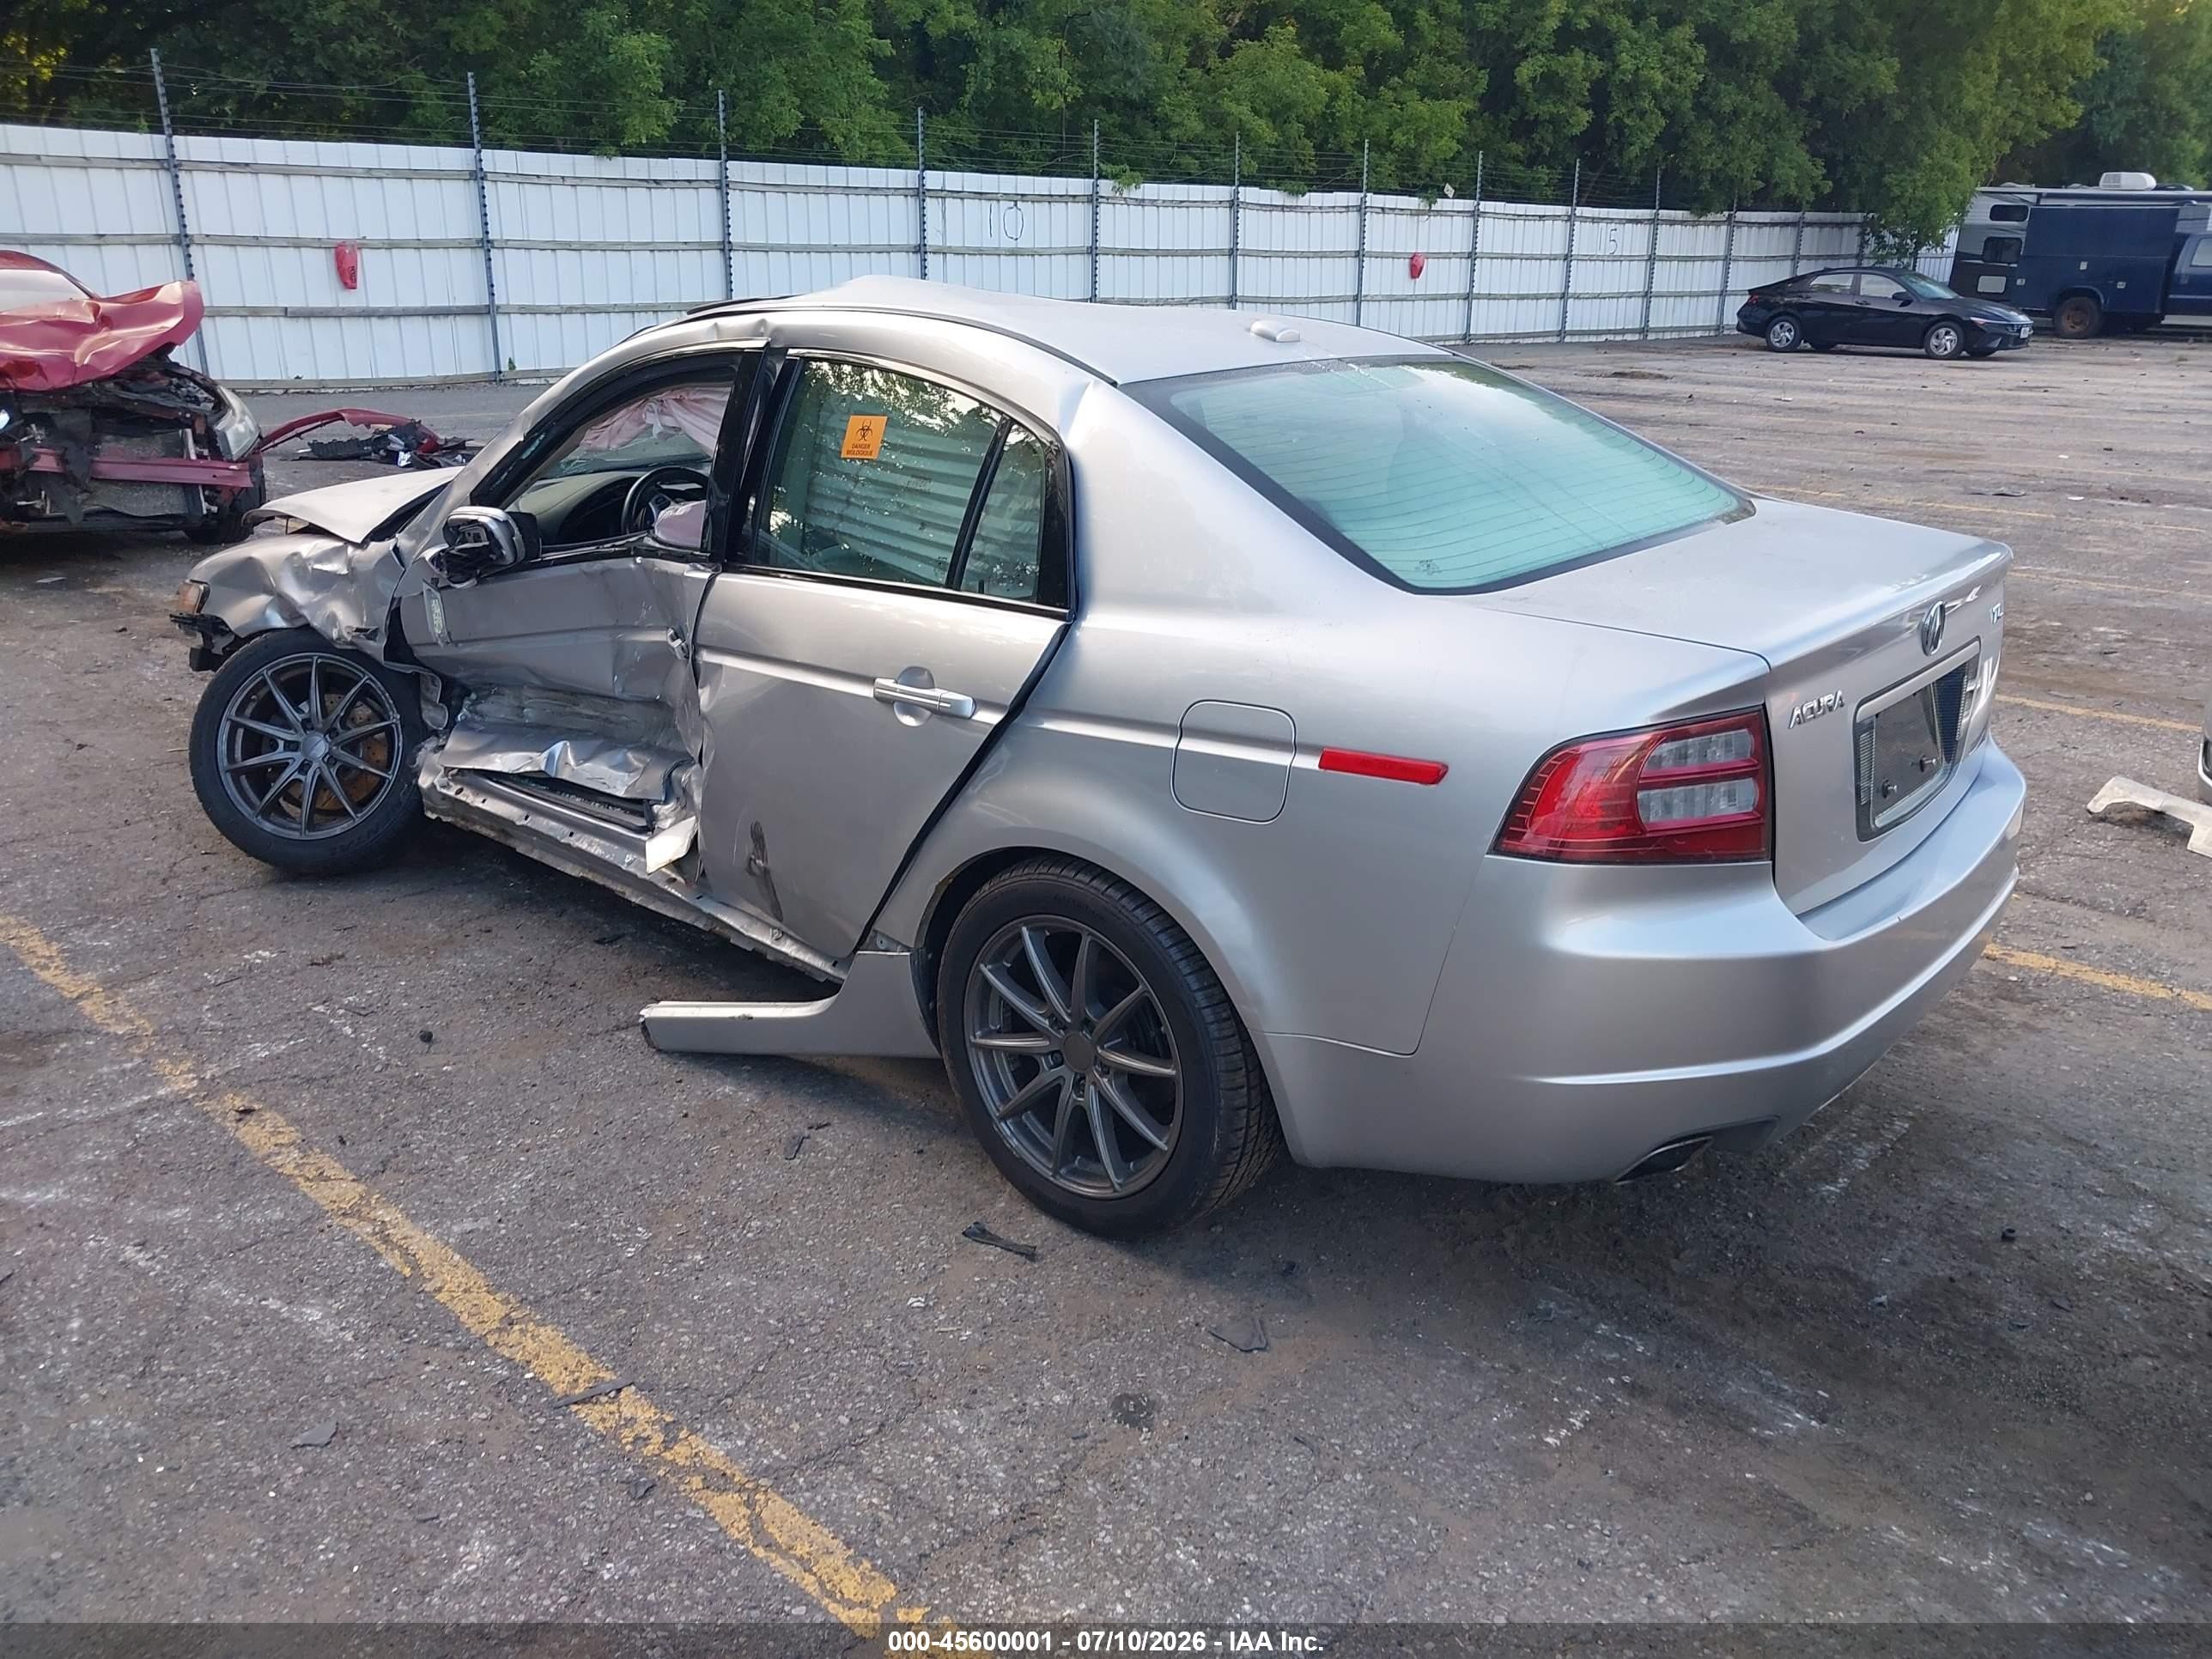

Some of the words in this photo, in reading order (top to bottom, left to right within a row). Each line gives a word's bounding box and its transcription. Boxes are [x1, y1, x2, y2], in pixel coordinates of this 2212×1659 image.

[988, 202, 1024, 241] 10
[1598, 228, 1619, 255] 15
[1788, 690, 1844, 730] ACURA
